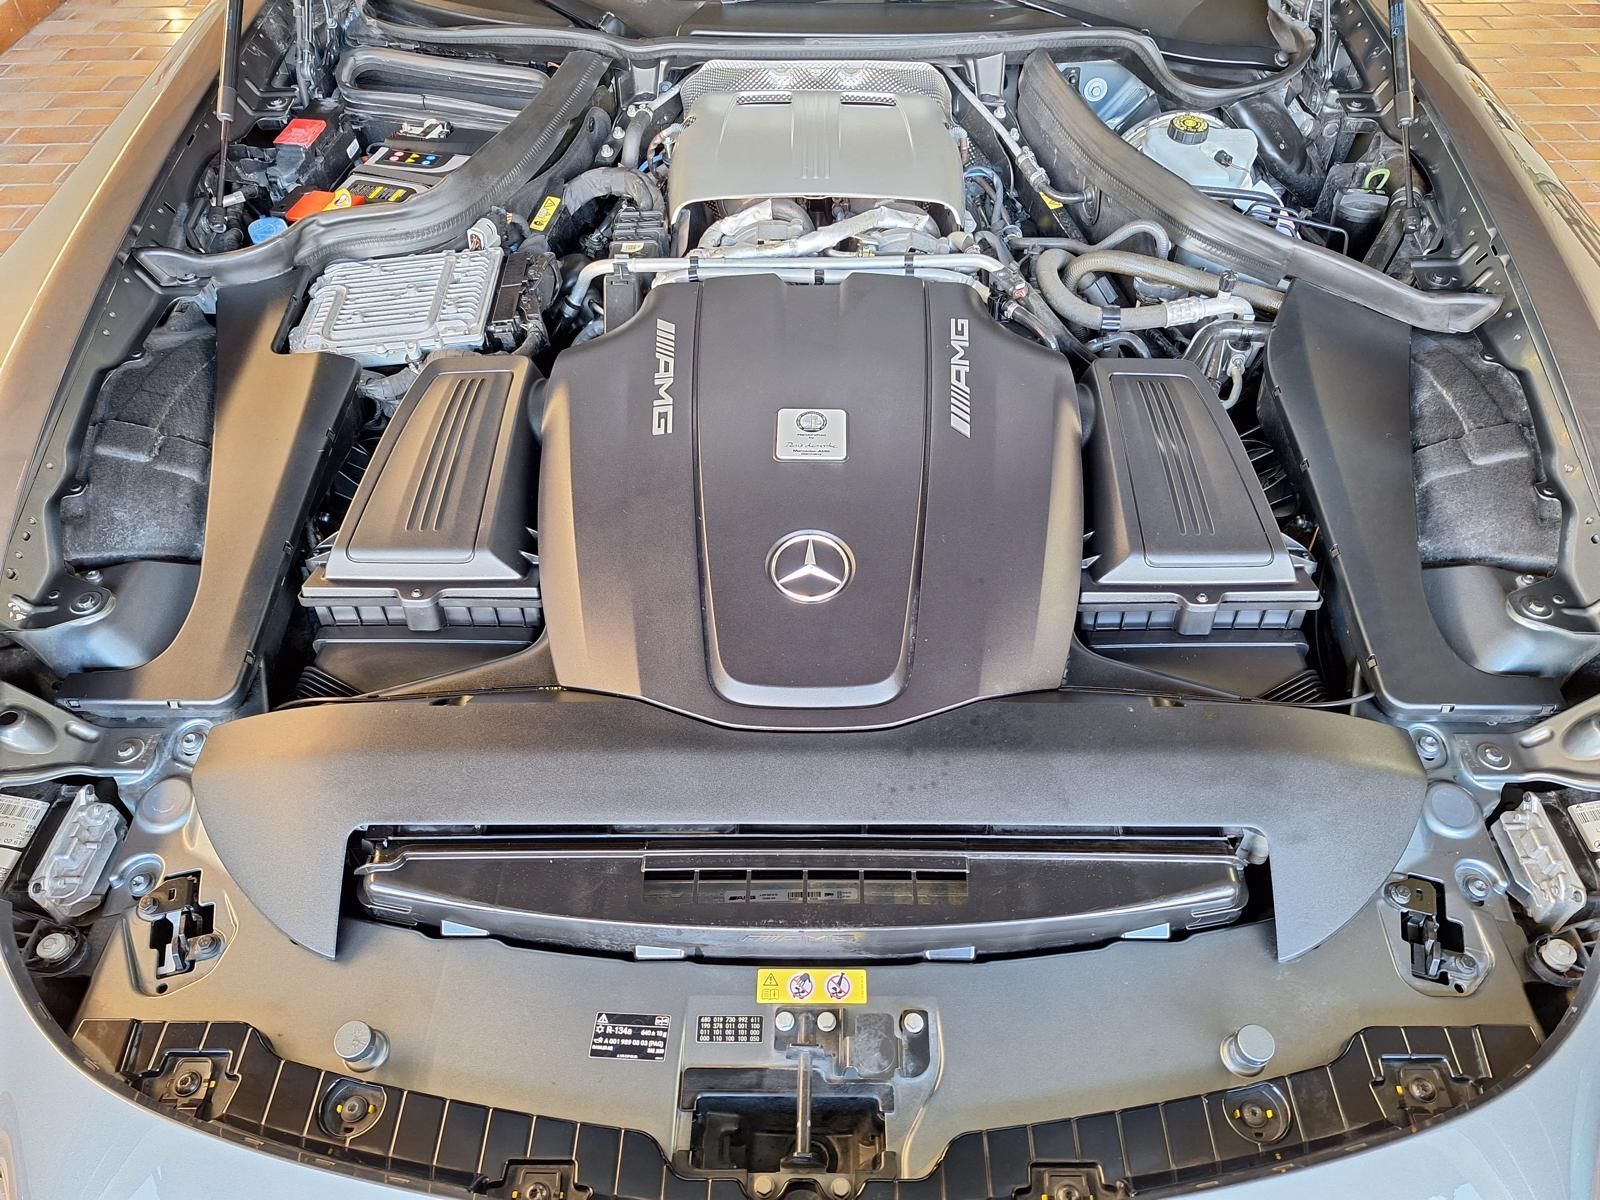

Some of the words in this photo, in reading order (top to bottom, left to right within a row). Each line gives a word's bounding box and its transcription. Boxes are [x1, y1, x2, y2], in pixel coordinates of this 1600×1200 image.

[950, 317, 970, 387] AMG
[652, 353, 674, 435] AMG
[606, 1026, 633, 1035] R-134a
